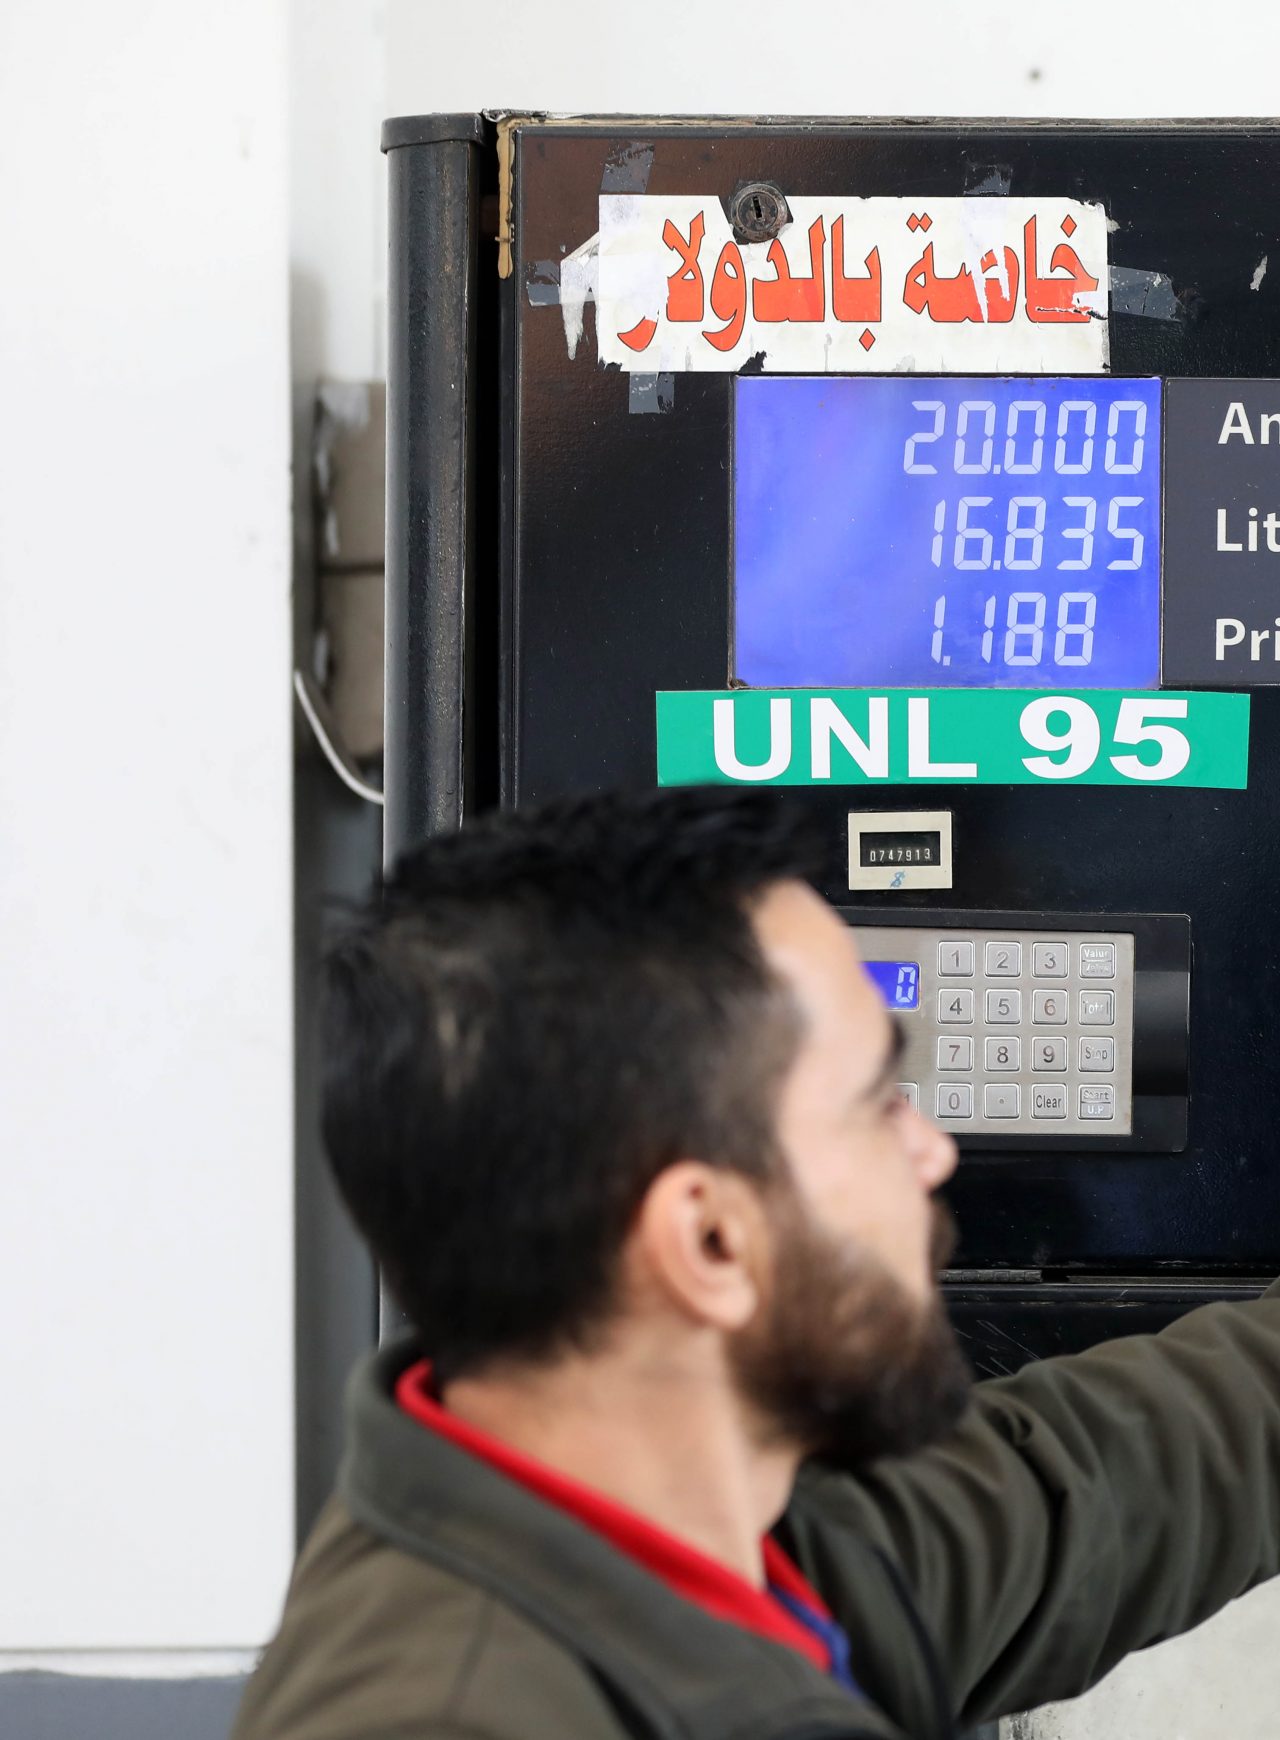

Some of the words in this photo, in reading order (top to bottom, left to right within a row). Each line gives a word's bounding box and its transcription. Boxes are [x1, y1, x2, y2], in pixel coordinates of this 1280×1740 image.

[902, 212, 1100, 324] خاصة
[903, 400, 1148, 476] 20.000
[930, 496, 1145, 572] 16.835
[930, 591, 1098, 667] 1.188
[712, 695, 978, 781] UNL
[1018, 694, 1192, 782] 95
[869, 847, 931, 862] 0747913
[951, 949, 960, 968] 1
[996, 951, 1009, 969] 2
[1043, 952, 1057, 970] 3
[895, 966, 916, 1003] 0
[949, 997, 963, 1016] 4
[997, 998, 1010, 1016] 5
[1043, 998, 1057, 1017] 6
[948, 1044, 961, 1063] 7
[996, 1045, 1009, 1064] 8
[1042, 1045, 1056, 1064] 9
[1035, 1094, 1062, 1109] Clear
